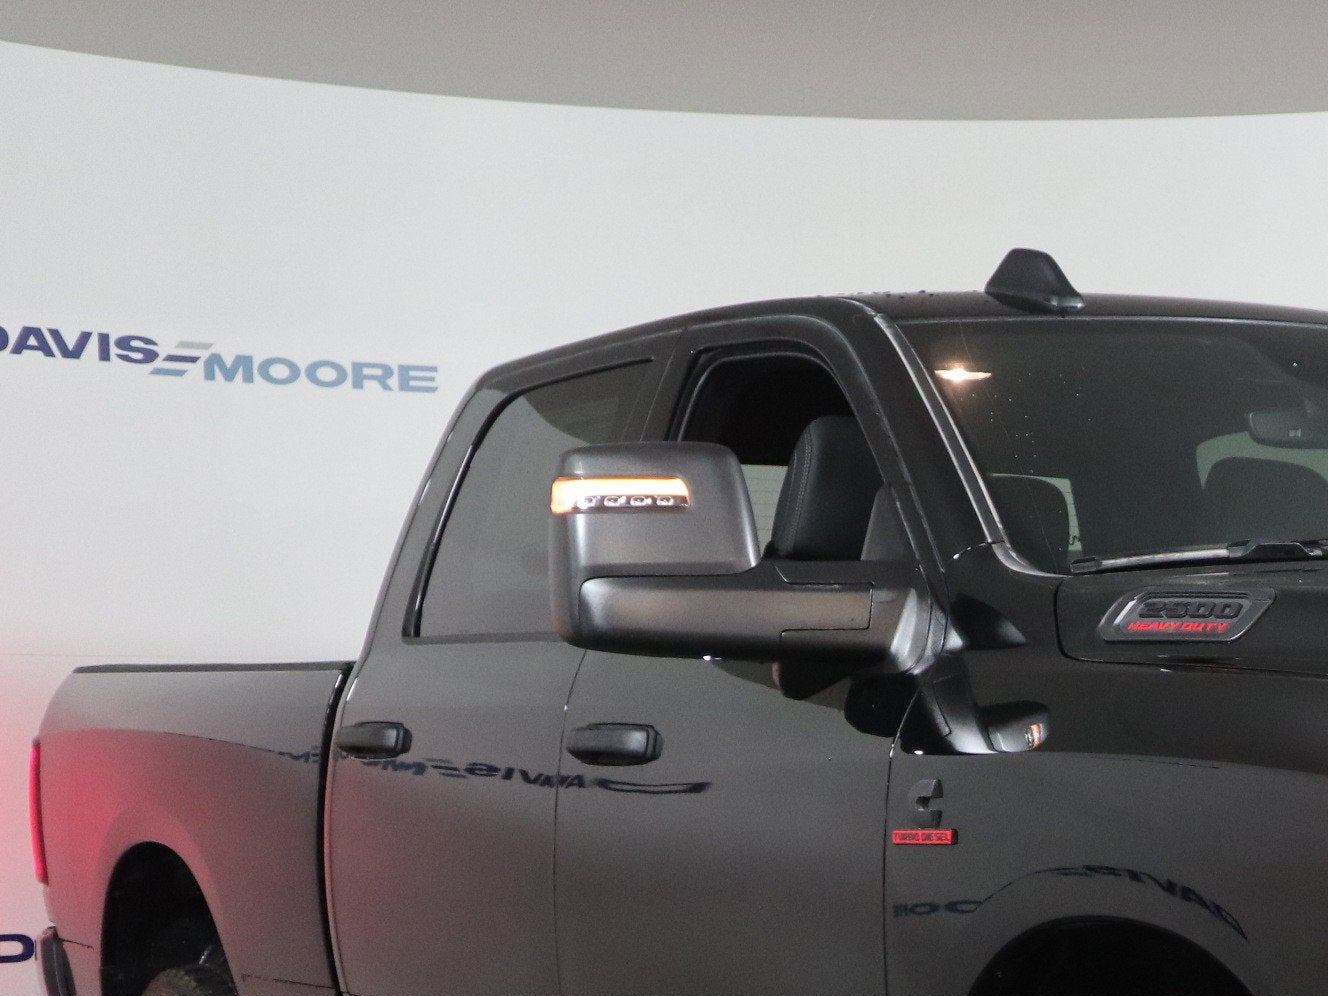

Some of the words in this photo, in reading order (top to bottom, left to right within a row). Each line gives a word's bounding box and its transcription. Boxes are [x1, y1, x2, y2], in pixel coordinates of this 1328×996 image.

[0, 325, 159, 364] AVIS
[203, 352, 439, 393] MOORE
[1138, 601, 1243, 619] 2500
[1126, 621, 1180, 632] HEAVY
[1181, 621, 1232, 632] DUTY
